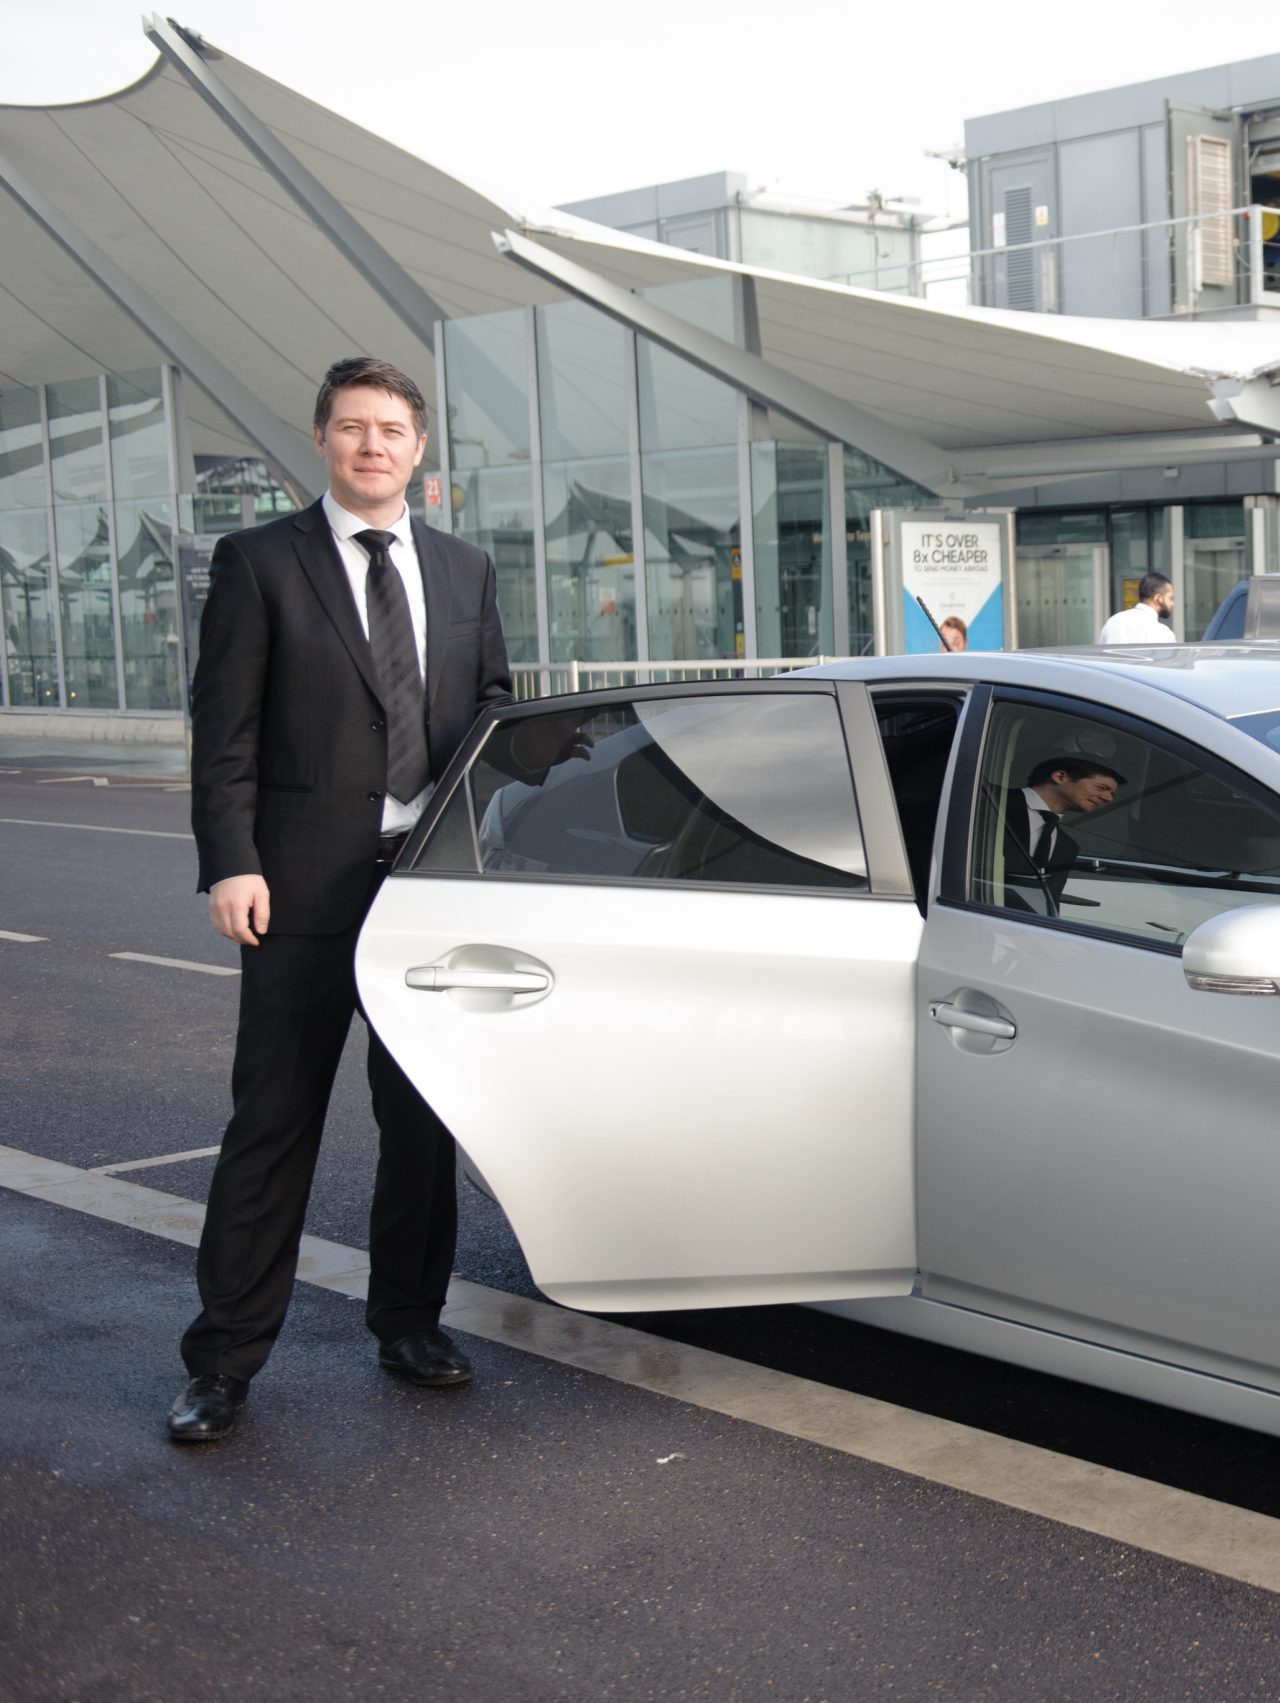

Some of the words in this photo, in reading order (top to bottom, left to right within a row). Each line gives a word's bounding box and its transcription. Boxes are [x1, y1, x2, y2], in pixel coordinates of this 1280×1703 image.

[426, 479, 439, 496] 21
[921, 533, 943, 548] IT'S
[945, 533, 979, 548] OVER
[913, 549, 928, 563] 8x
[931, 549, 988, 563] CHEAPER
